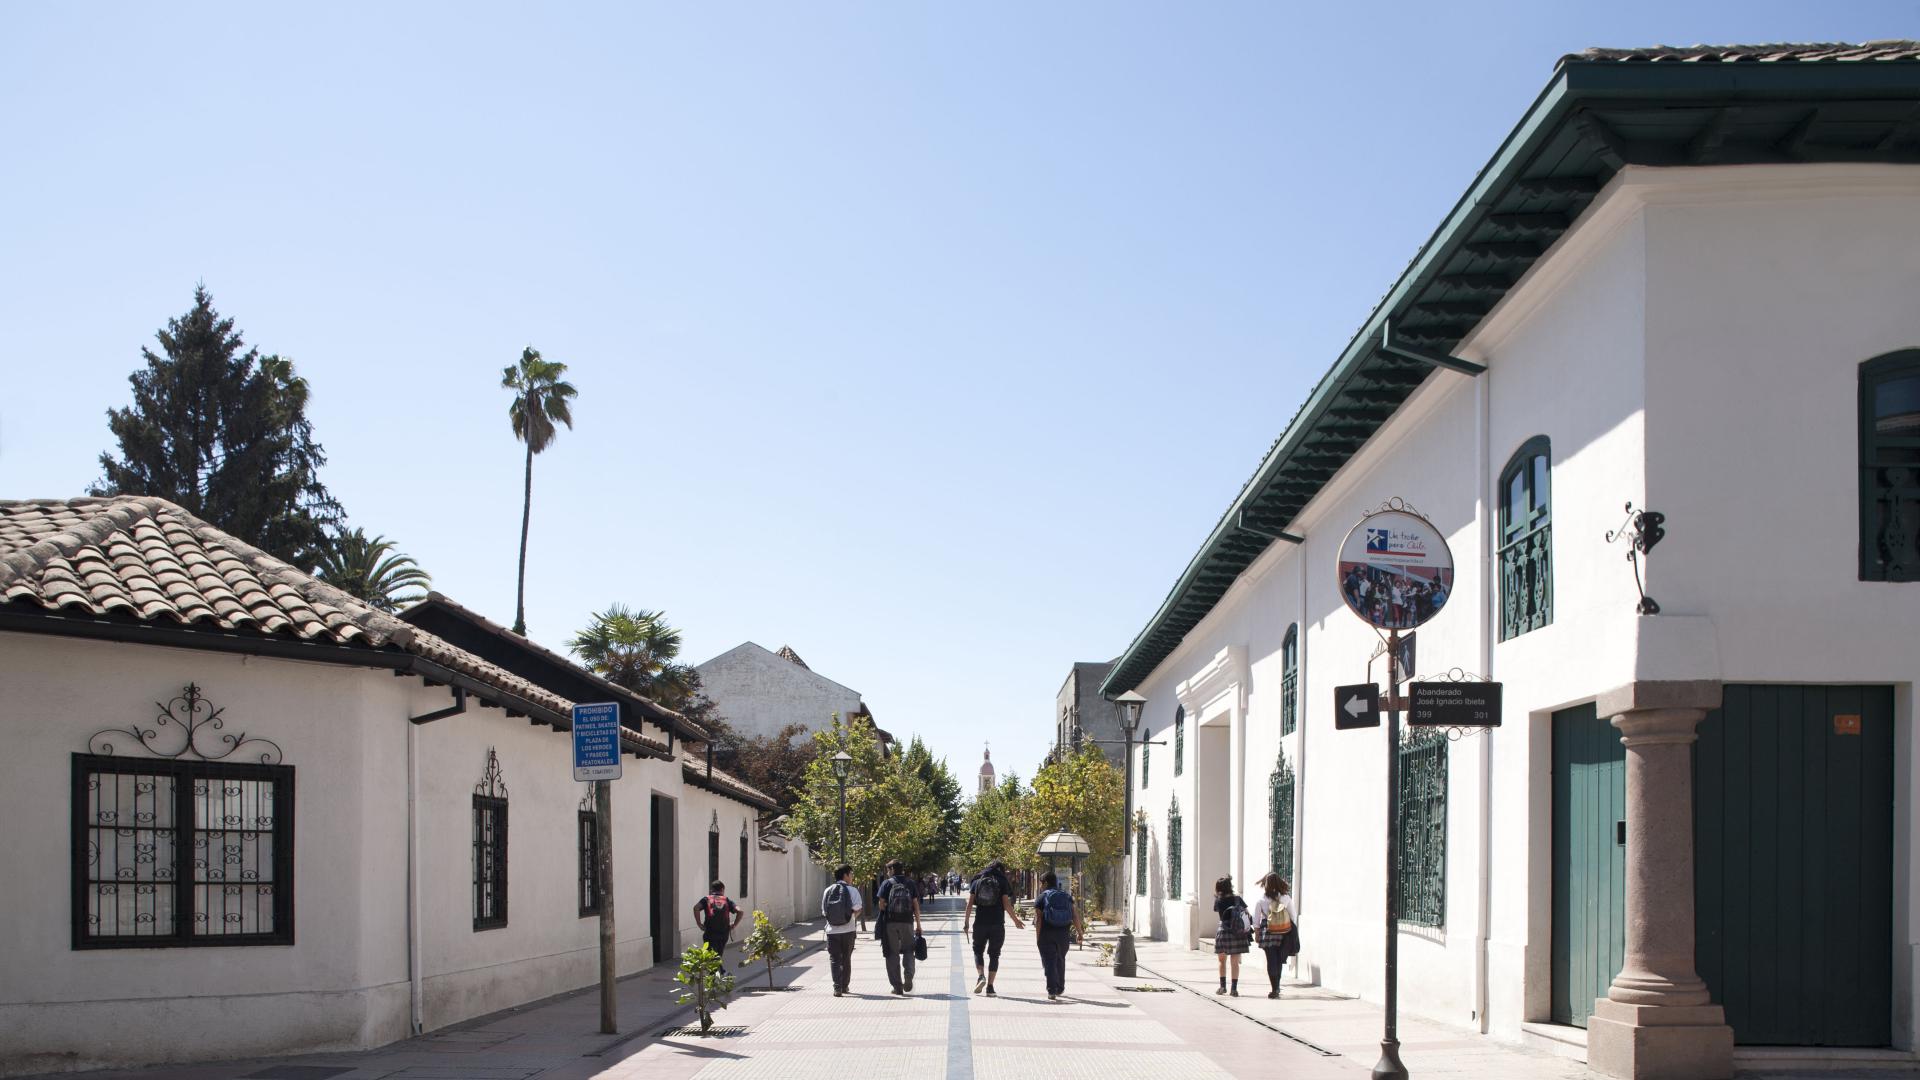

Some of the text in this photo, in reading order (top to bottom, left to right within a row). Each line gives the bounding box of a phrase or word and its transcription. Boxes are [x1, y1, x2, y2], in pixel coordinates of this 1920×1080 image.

[1388, 543, 1405, 552] para
[1416, 688, 1462, 696] Abanderado
[1416, 697, 1435, 705] José
[1436, 698, 1463, 707] Ignacio
[579, 706, 613, 714] PROHIBIDO
[1416, 710, 1489, 719] 399 301
[581, 729, 609, 737] BICICLETAS
